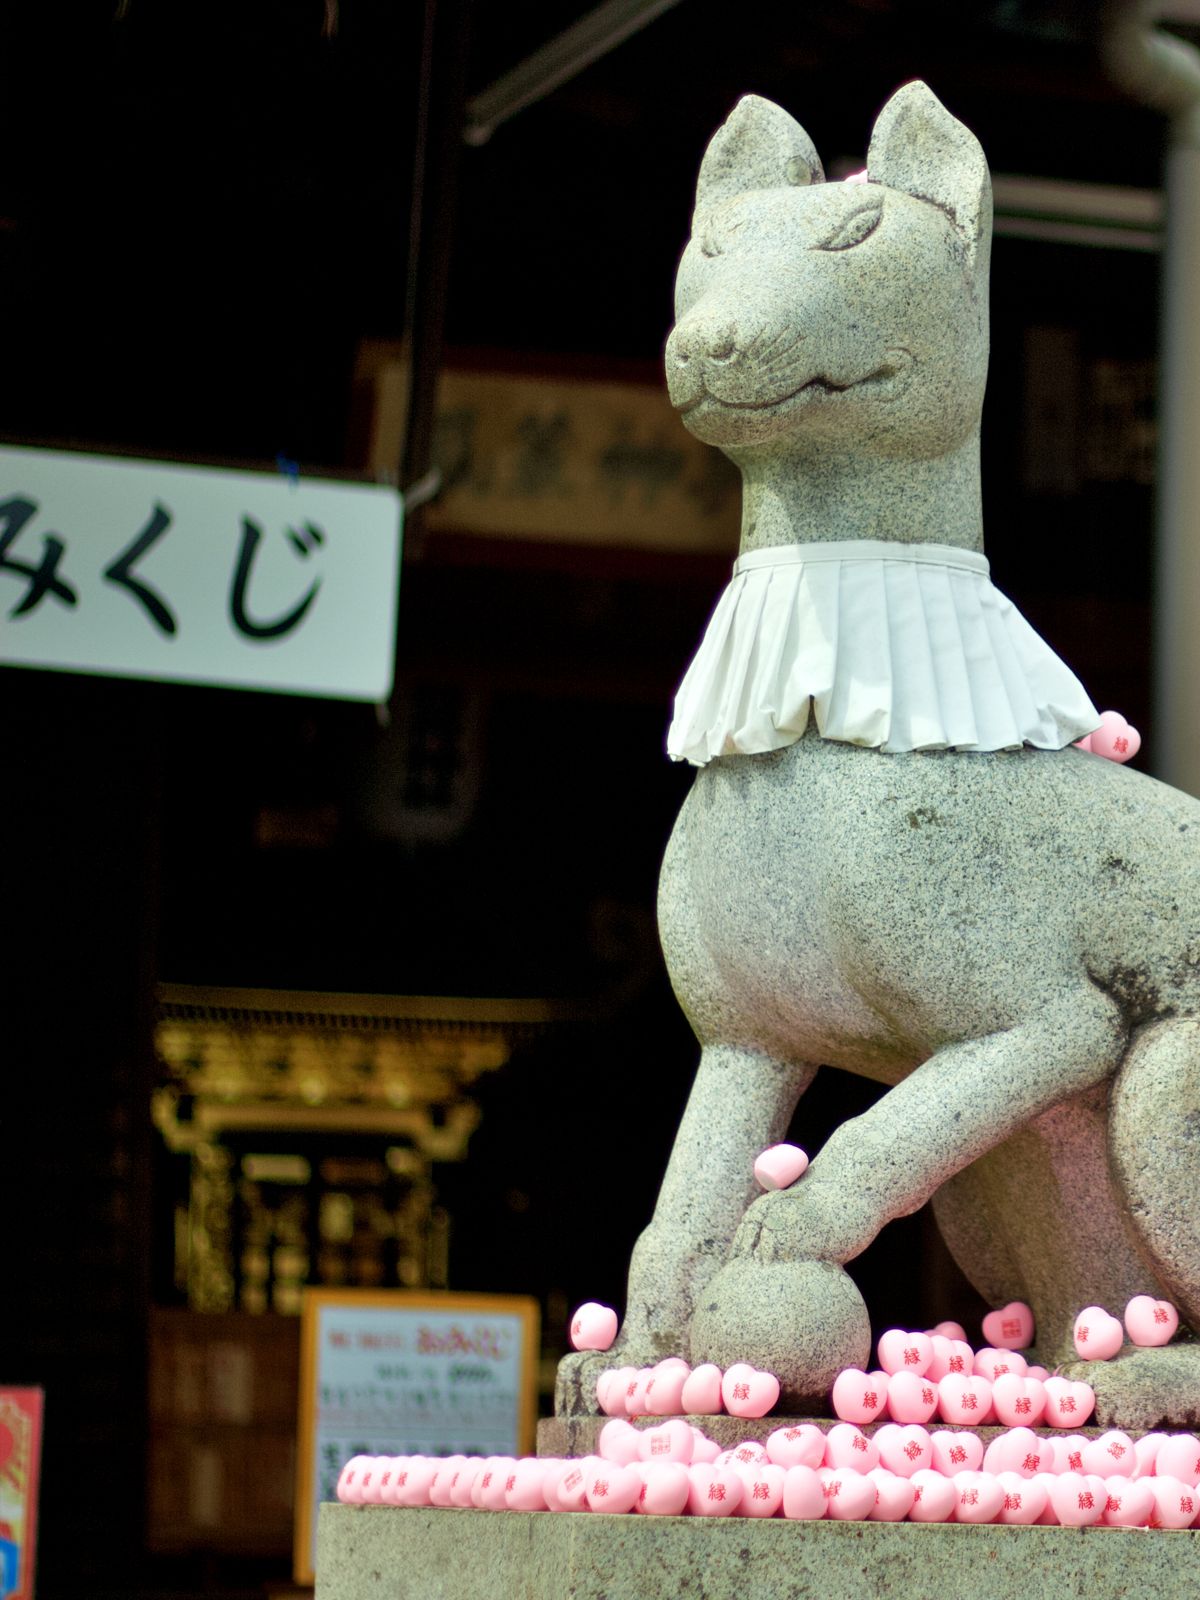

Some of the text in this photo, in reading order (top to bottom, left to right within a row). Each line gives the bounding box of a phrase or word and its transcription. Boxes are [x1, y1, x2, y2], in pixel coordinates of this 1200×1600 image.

[904, 1348, 921, 1365] 縁
[949, 1356, 964, 1372] 縁
[733, 1383, 749, 1400] 縁
[922, 1388, 934, 1404] 縁
[863, 1392, 877, 1409] 縁
[962, 1394, 977, 1410] 縁
[1015, 1398, 1031, 1414] 縁
[1060, 1397, 1076, 1413] 縁
[852, 1434, 869, 1452] 縁
[904, 1441, 923, 1461] 縁
[949, 1446, 968, 1464] 縁
[1022, 1453, 1040, 1472] 縁
[1068, 1451, 1082, 1470] 縁
[592, 1480, 608, 1496] 縁
[708, 1484, 726, 1500] 縁
[753, 1482, 770, 1500] 縁
[961, 1490, 978, 1505] 縁
[1003, 1494, 1021, 1510] 縁
[1078, 1492, 1094, 1509] 縁
[1180, 1496, 1193, 1513] 縁
